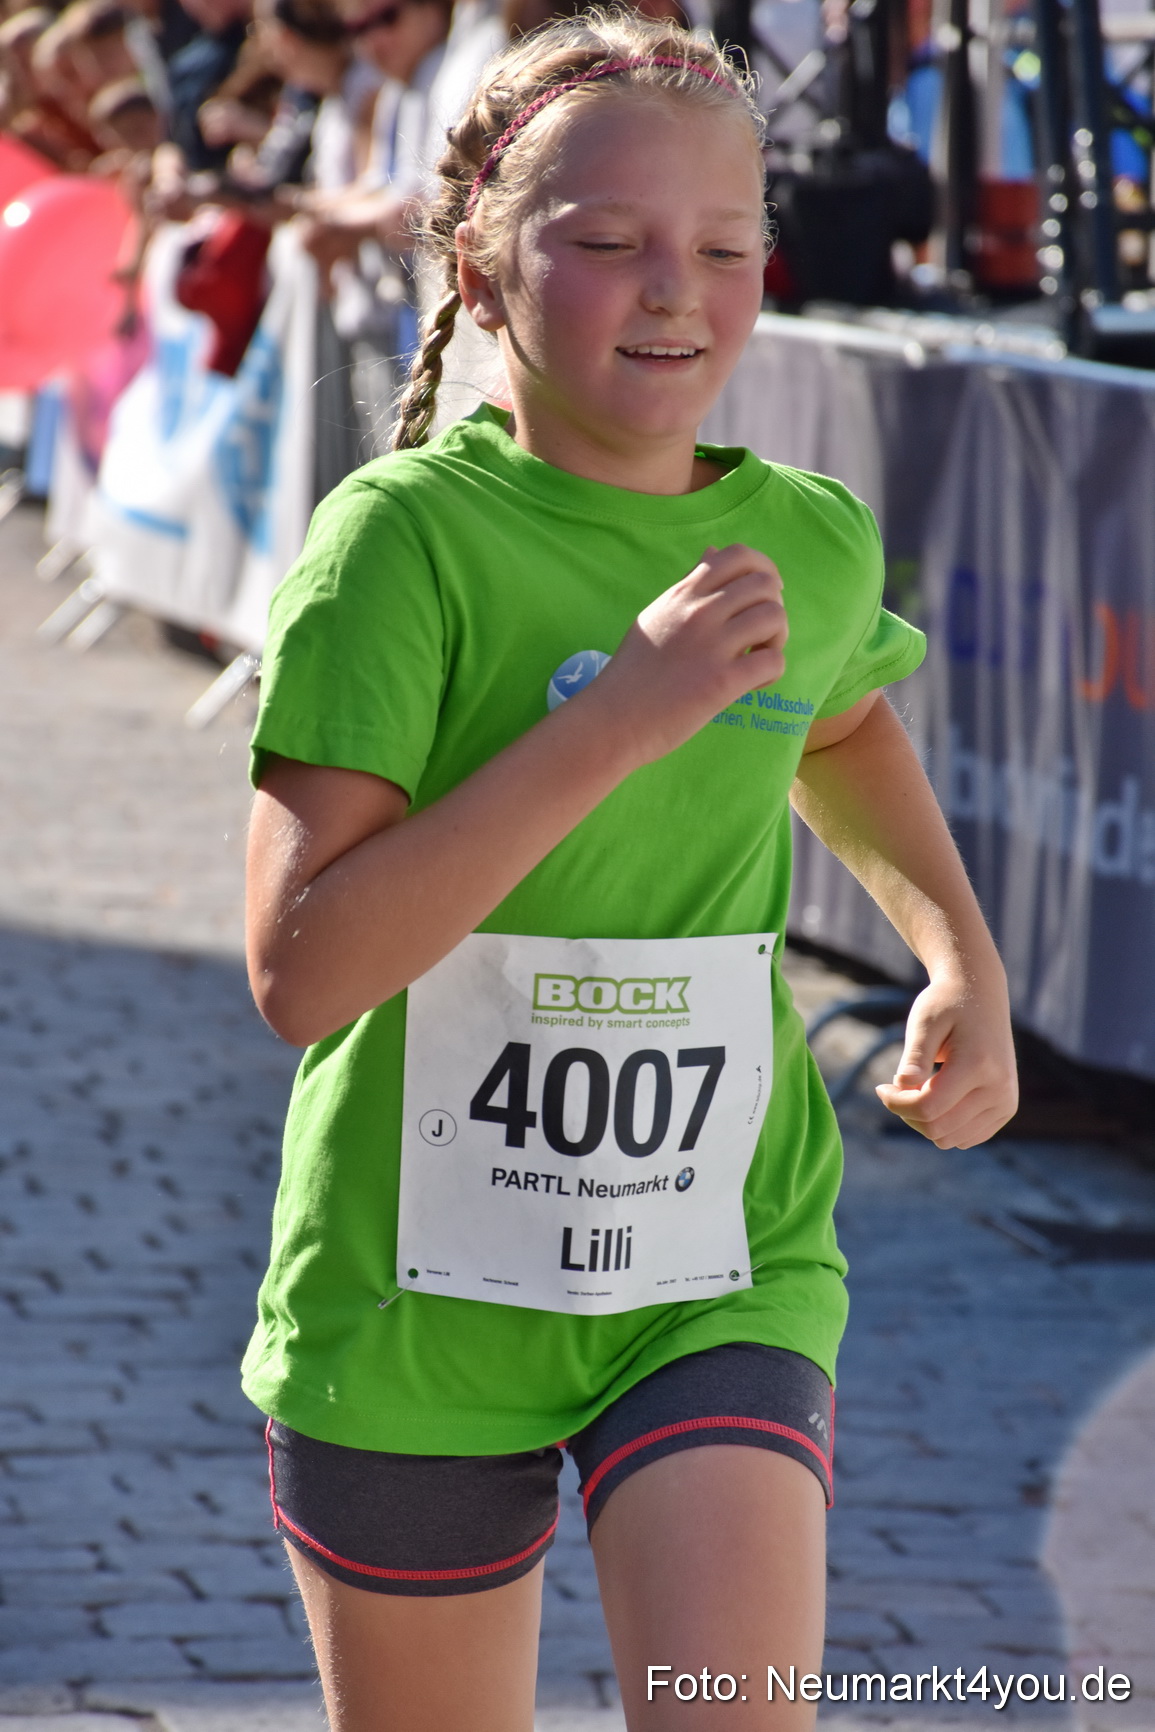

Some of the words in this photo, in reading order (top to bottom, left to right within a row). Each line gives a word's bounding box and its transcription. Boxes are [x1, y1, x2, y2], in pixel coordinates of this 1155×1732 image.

[756, 690, 815, 716] Volksschule
[710, 708, 746, 730] arien,
[533, 973, 692, 1014] BOCK
[531, 1013, 584, 1028] inspired
[588, 1016, 604, 1030] by
[607, 1018, 643, 1029] smart
[645, 1016, 691, 1030] concepts
[469, 1041, 726, 1158] 4007
[431, 1119, 443, 1138] J
[491, 1167, 571, 1197] PARTL
[577, 1174, 669, 1199] Neumarkt
[560, 1225, 633, 1273] Lilli
